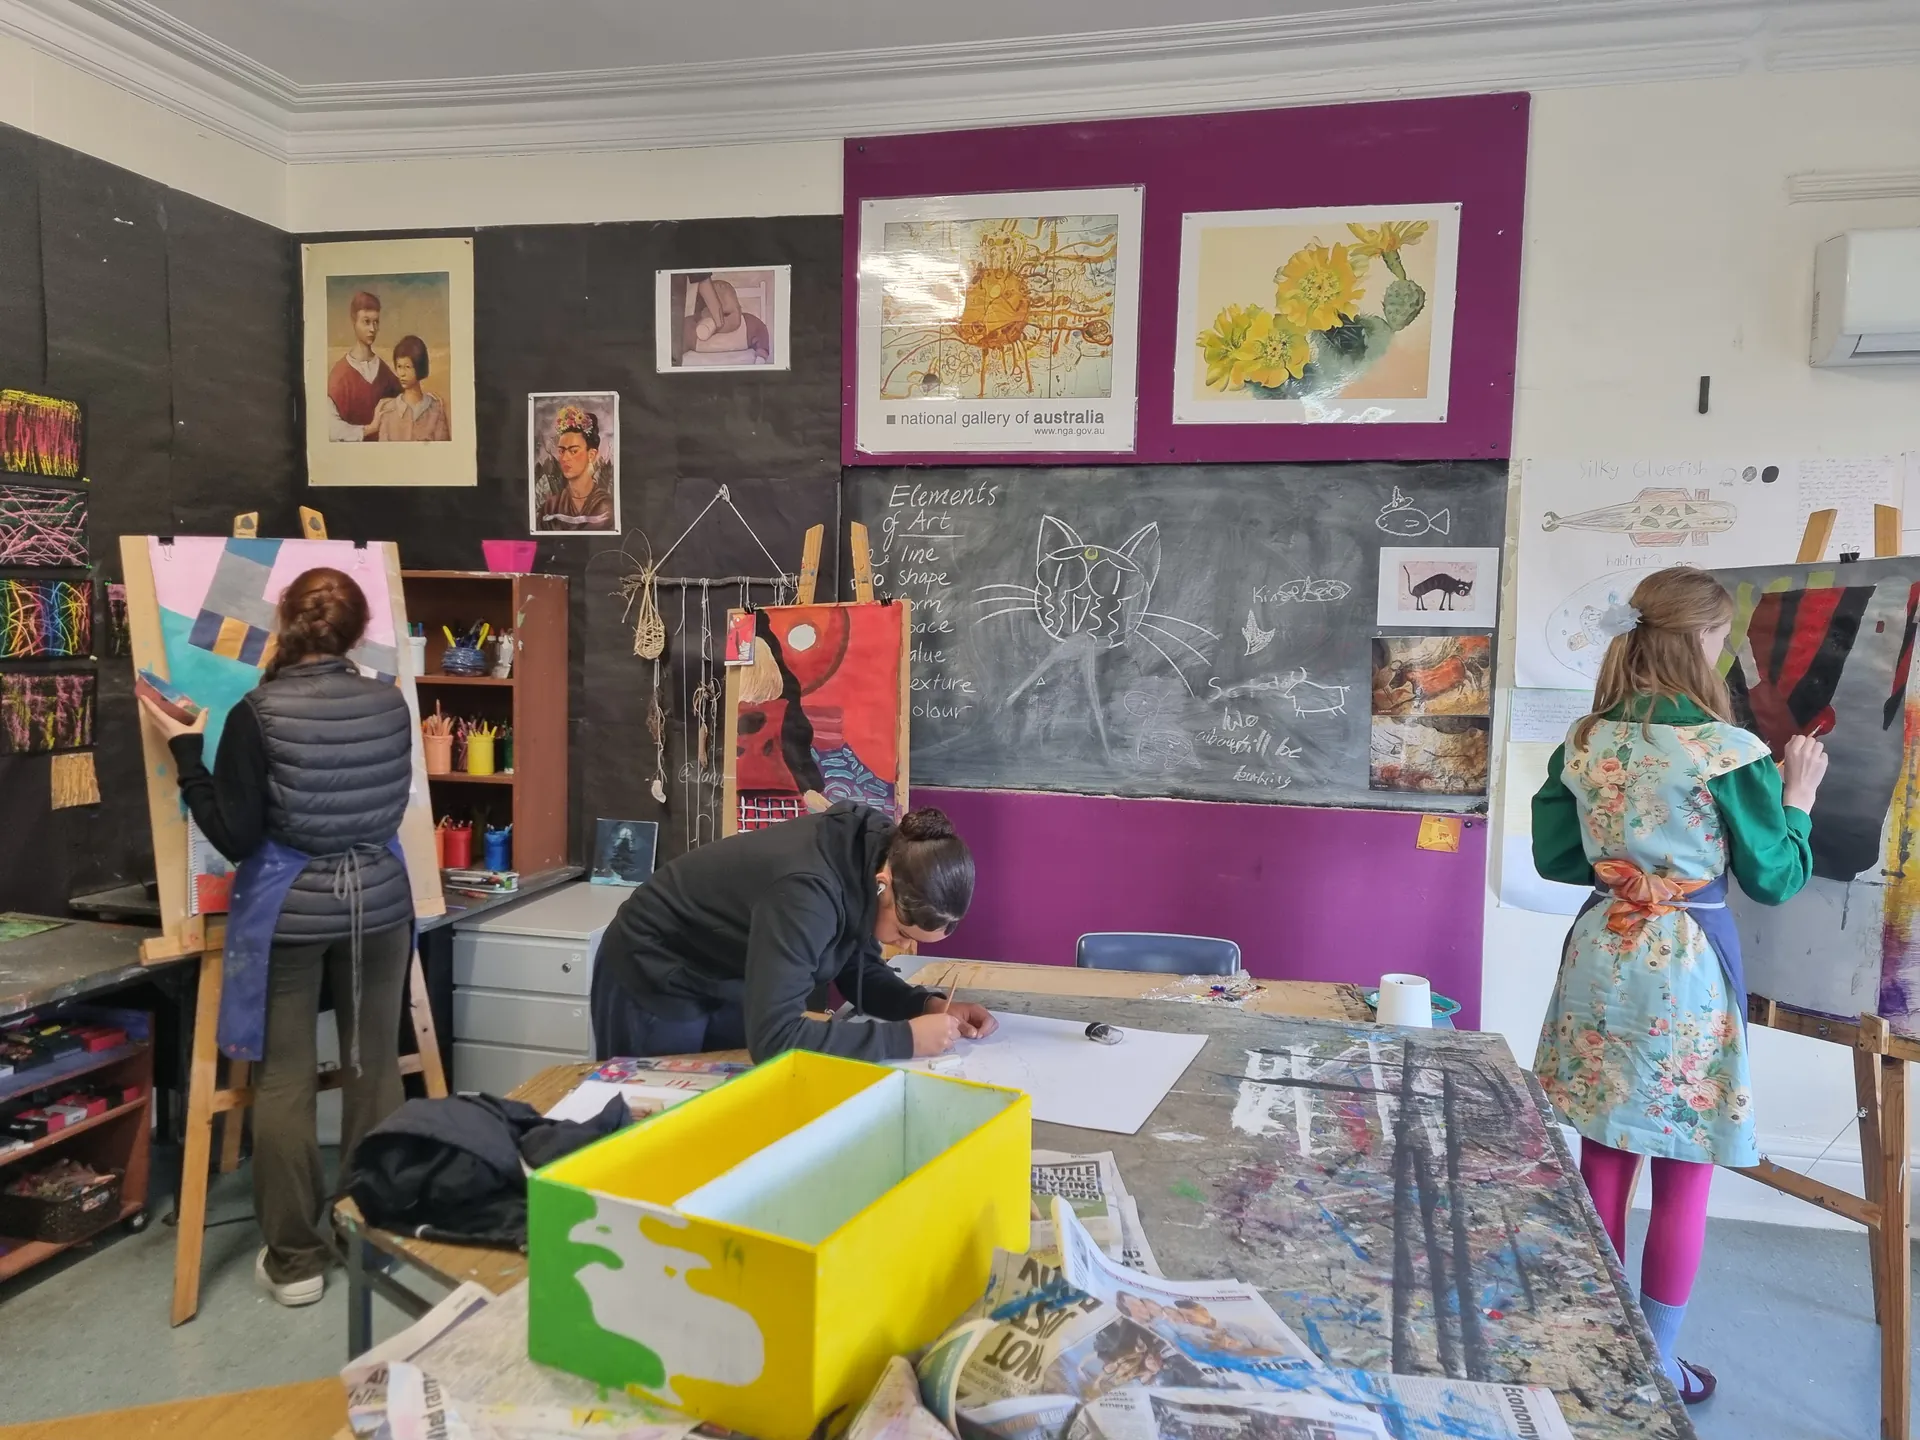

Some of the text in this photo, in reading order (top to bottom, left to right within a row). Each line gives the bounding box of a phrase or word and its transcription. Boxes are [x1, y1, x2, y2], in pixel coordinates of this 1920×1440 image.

[901, 409, 1105, 427] national gallery of australia
[1034, 428, 1105, 436] www.nga.gov.au
[1633, 461, 1708, 478] Gluefish
[889, 481, 999, 507] Elements
[883, 509, 951, 552] of Art
[901, 545, 940, 564] line
[899, 568, 952, 595] shape
[910, 641, 946, 663] alue
[910, 673, 977, 693] exture
[912, 700, 973, 718] olour
[1502, 1386, 1540, 1440] Economy
